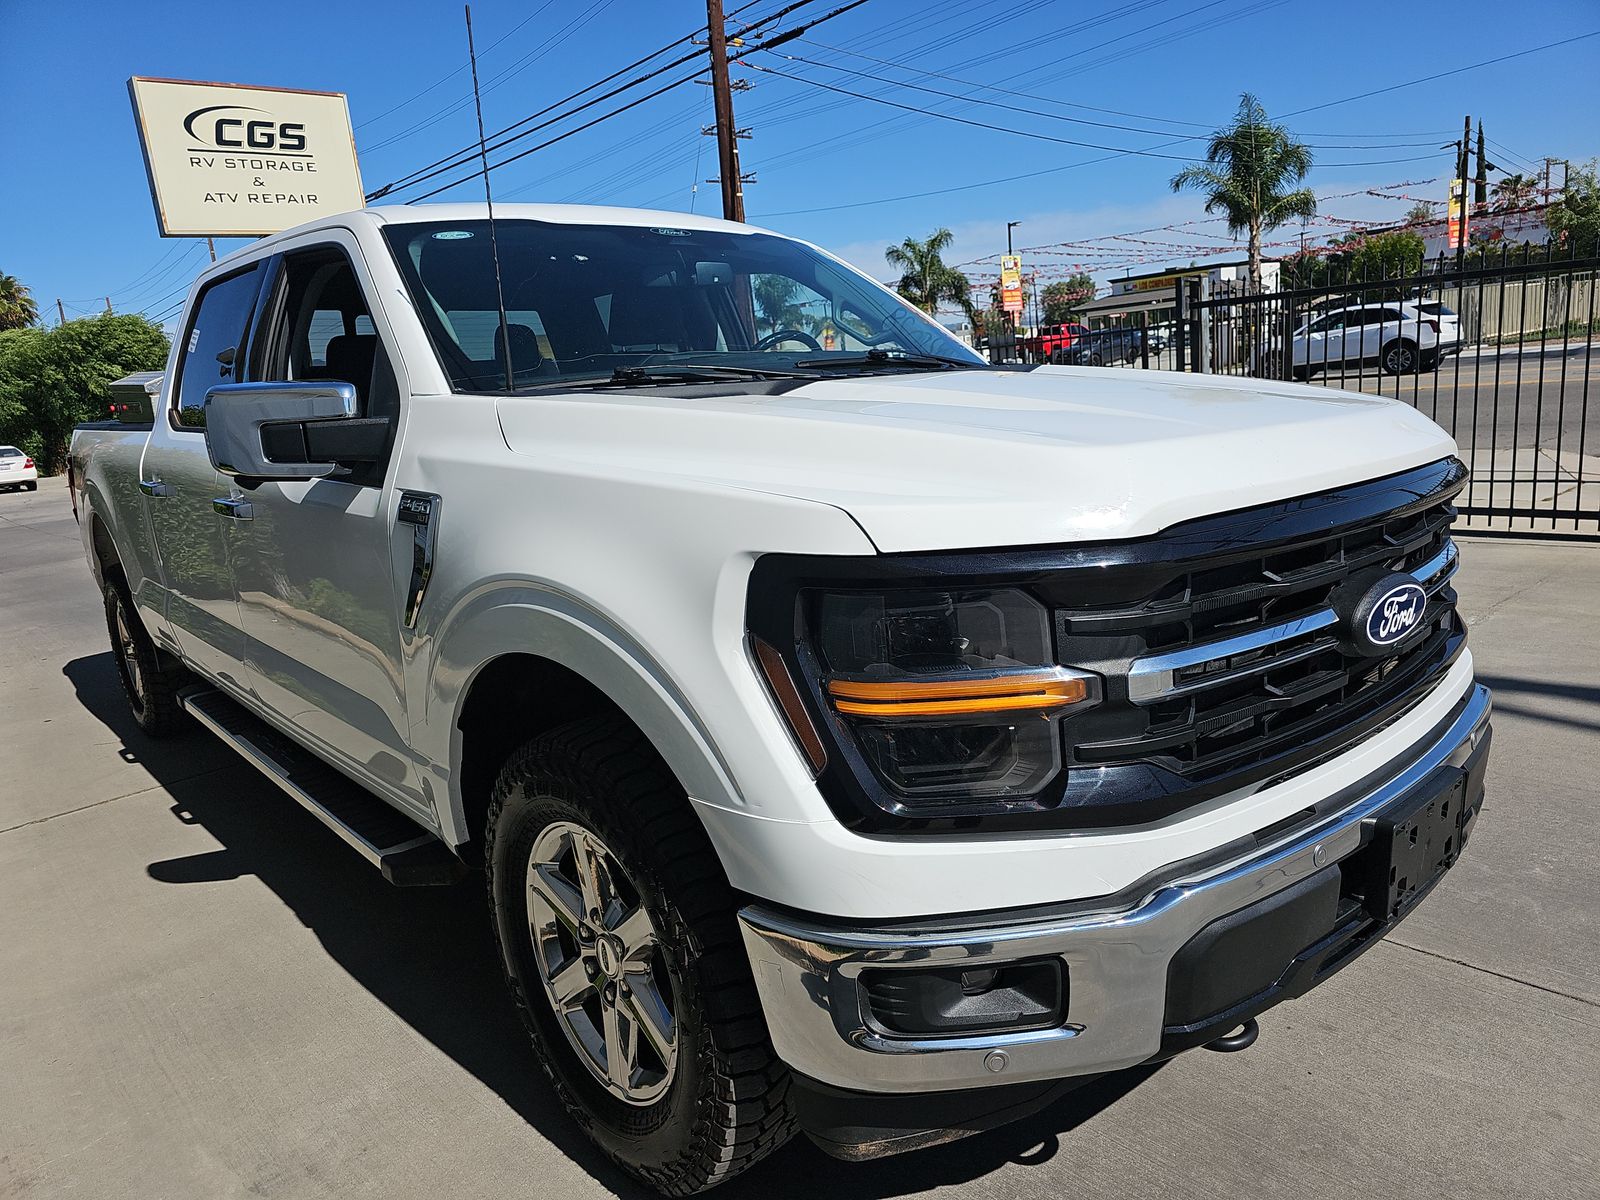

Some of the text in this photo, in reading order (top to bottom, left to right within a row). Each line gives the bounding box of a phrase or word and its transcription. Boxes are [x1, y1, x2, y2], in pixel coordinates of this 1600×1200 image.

[215, 118, 307, 151] CGS
[190, 157, 317, 173] RV STORAGE
[253, 176, 265, 187] &
[204, 192, 319, 205] ATV REPAIR
[1380, 593, 1417, 638] Ford
